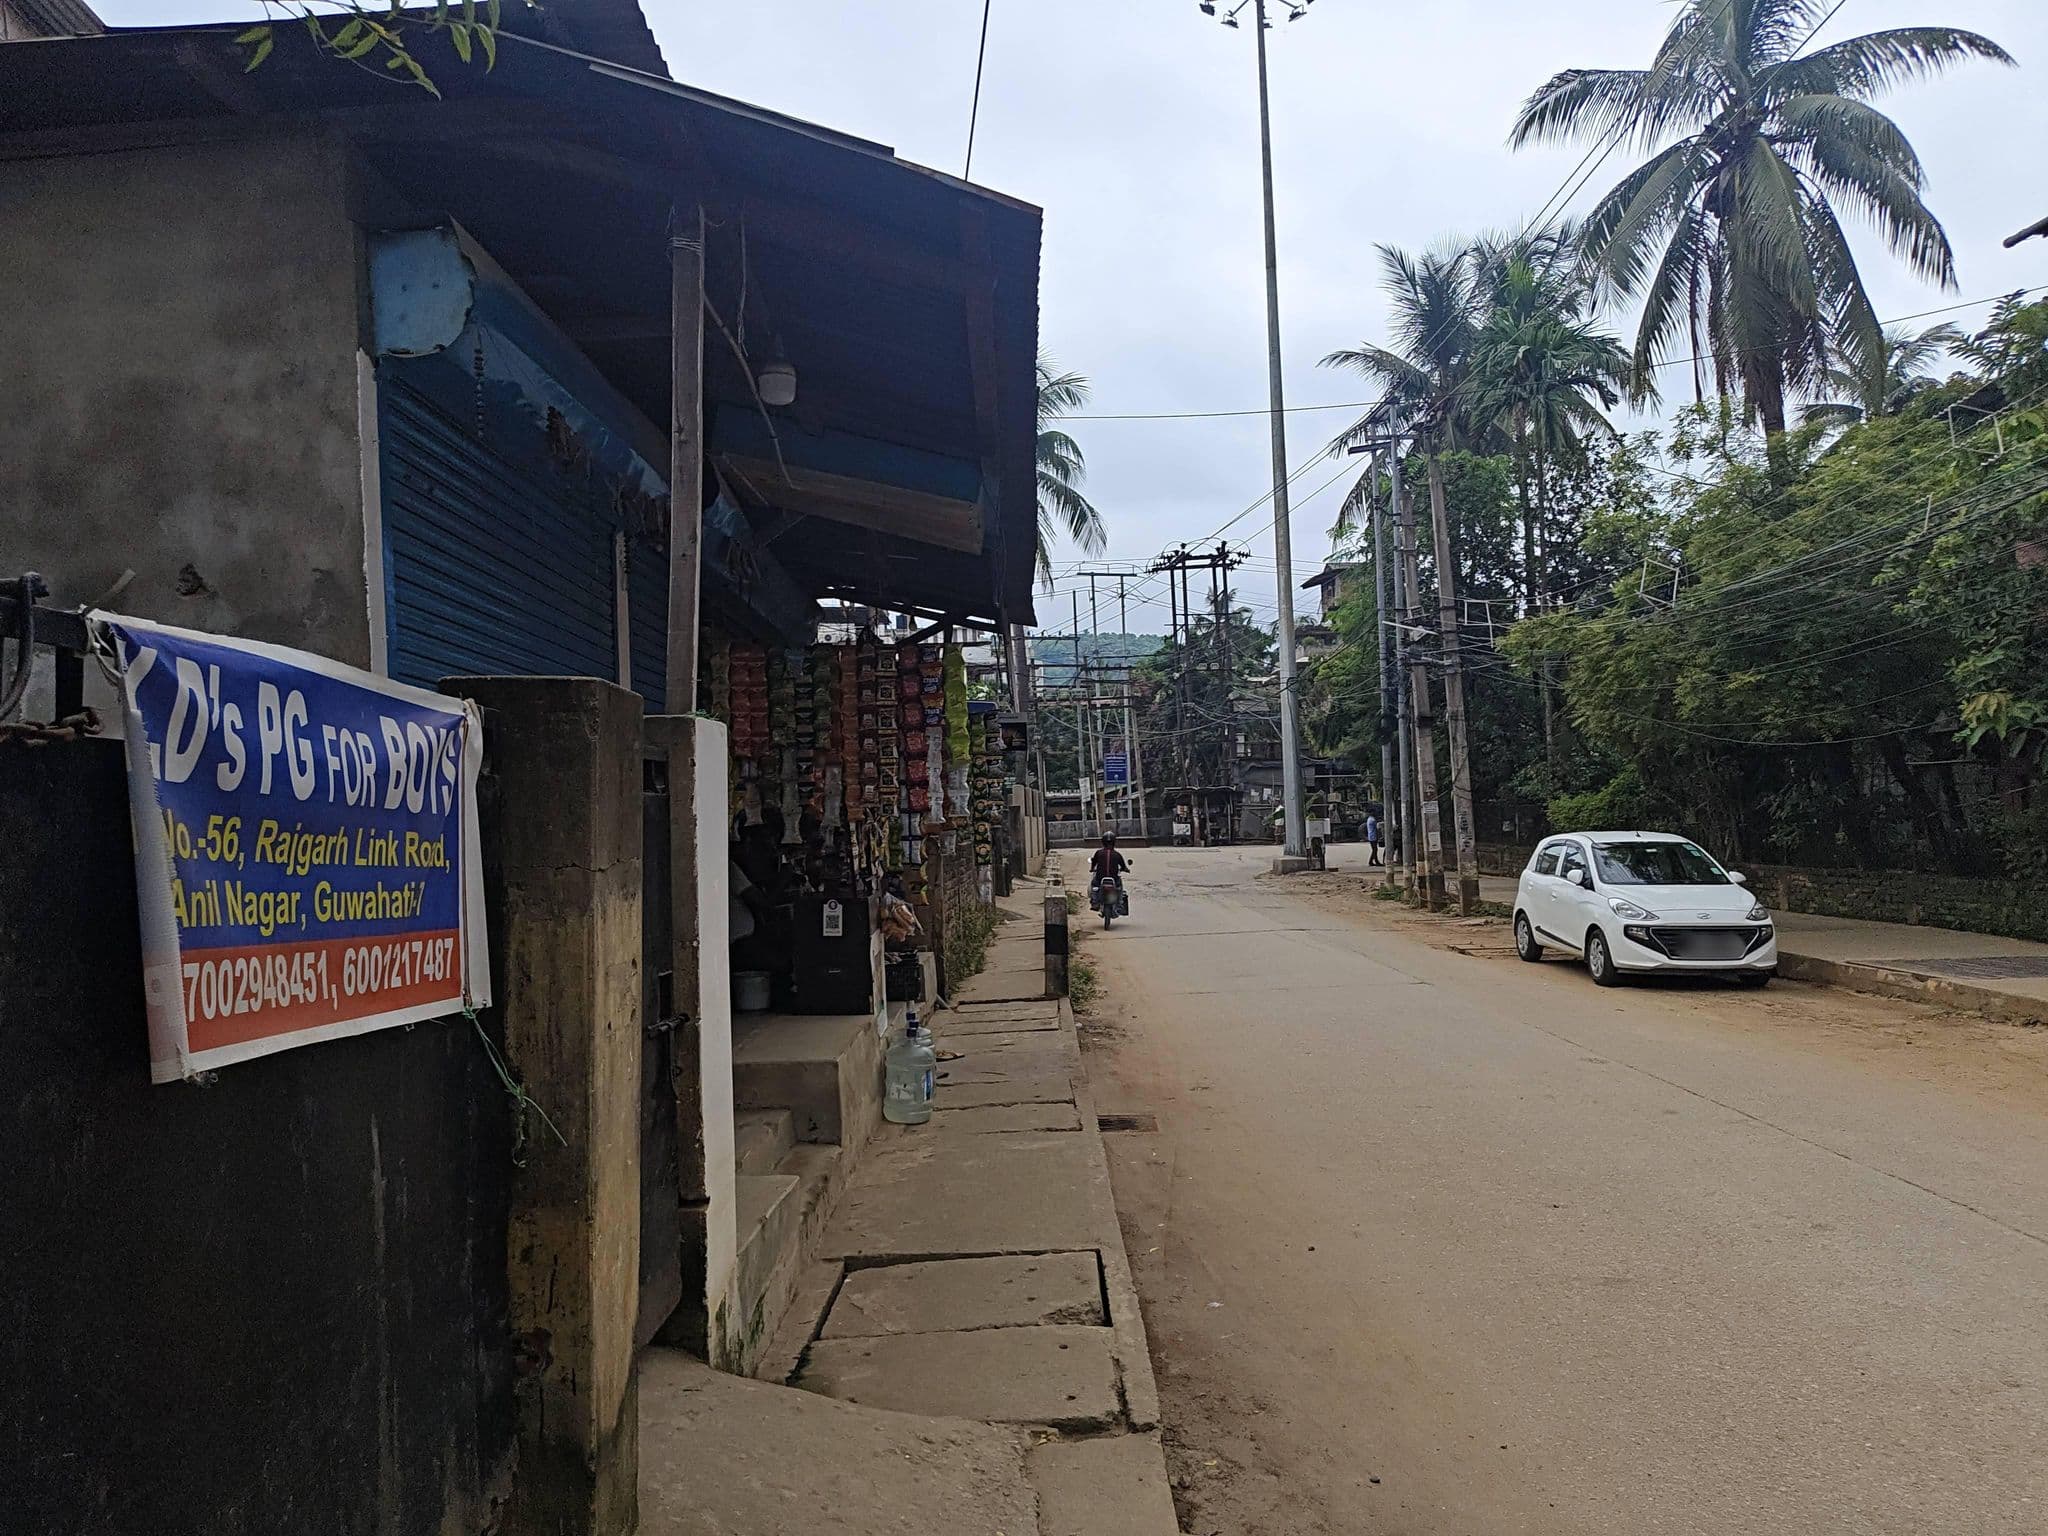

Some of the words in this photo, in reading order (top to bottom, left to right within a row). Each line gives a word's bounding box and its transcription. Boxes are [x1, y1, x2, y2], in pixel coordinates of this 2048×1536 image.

[258, 681, 315, 801] PG
[322, 724, 377, 808] FOR
[379, 715, 456, 817] BOYS
[255, 819, 348, 876] Rajgarh
[354, 828, 399, 867] Link
[172, 879, 222, 928] Anil
[225, 880, 306, 937] Nagar,
[183, 950, 338, 1022] 7002948451,
[343, 937, 454, 997] 6001217487
